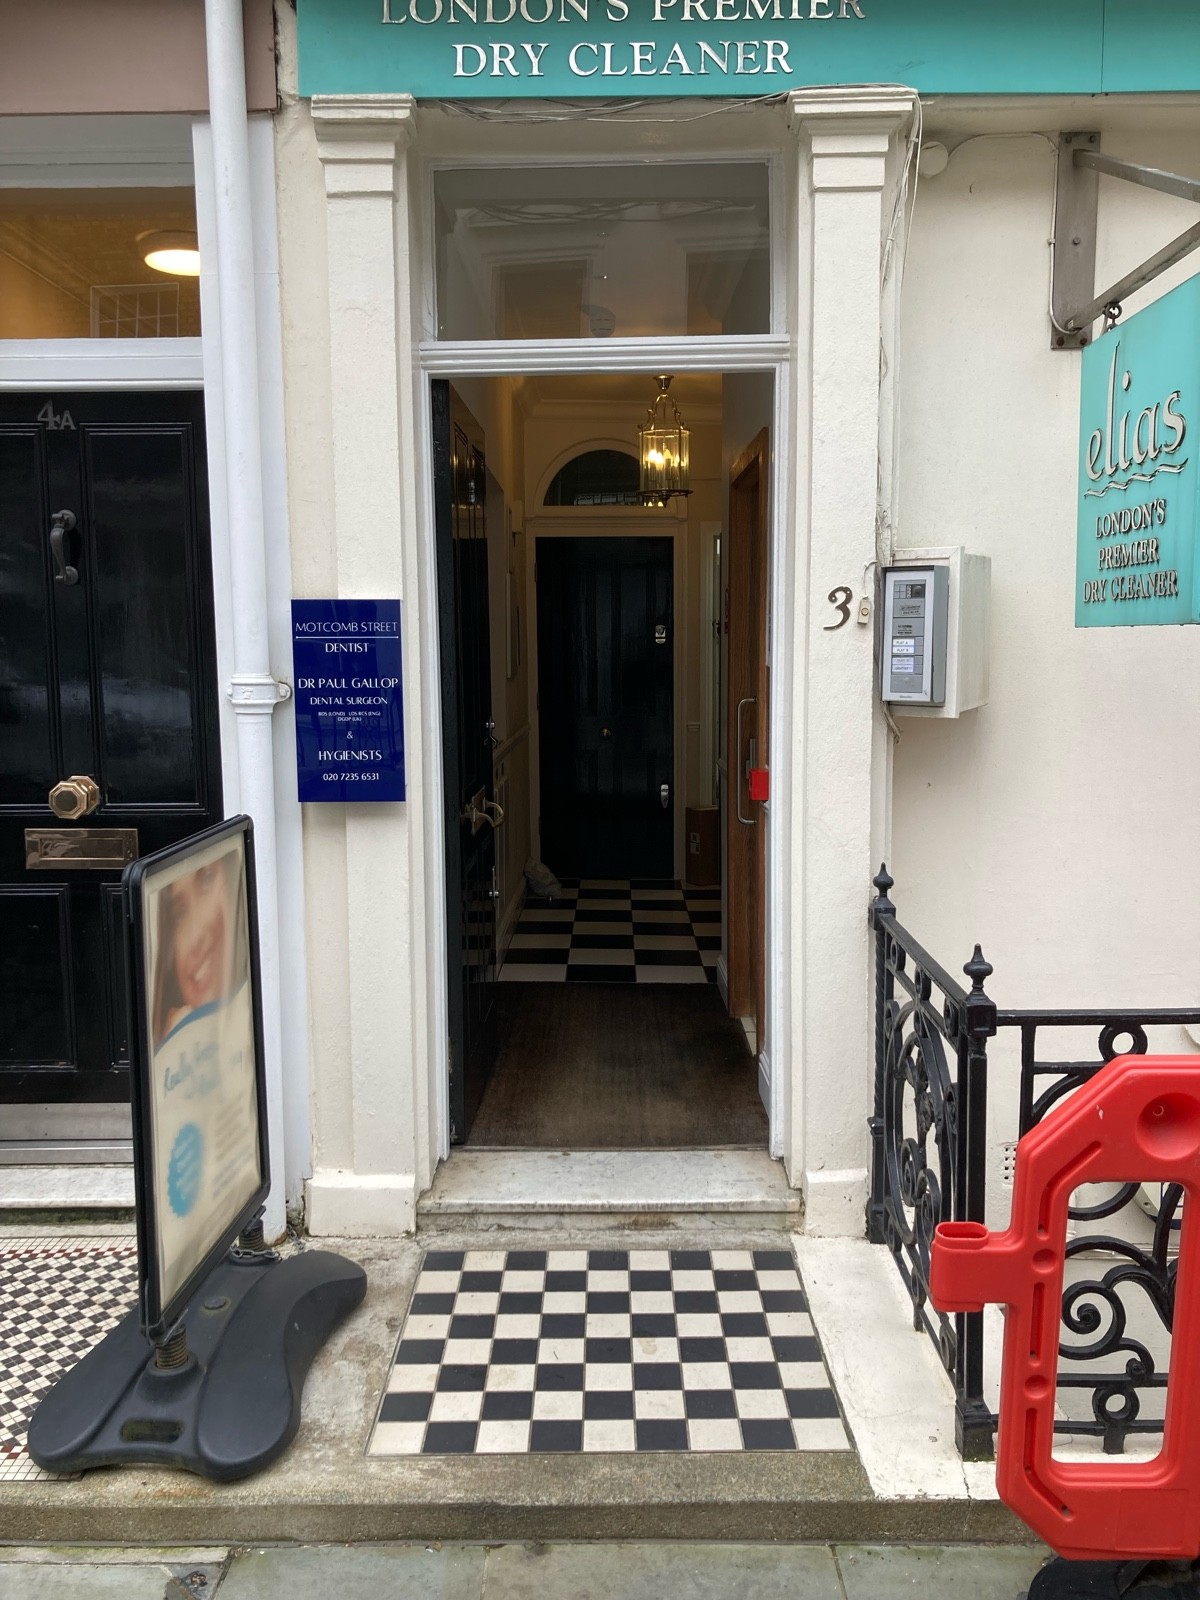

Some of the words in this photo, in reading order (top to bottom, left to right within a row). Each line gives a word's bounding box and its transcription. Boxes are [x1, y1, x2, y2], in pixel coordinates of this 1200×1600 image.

[380, 0, 629, 25] LONDONS
[651, 0, 867, 21] PREMIER
[452, 43, 549, 77] DRY
[568, 40, 794, 76] CLEANER
[37, 400, 77, 430] 4A
[1086, 340, 1186, 482] elias
[1095, 498, 1167, 539] LONDON'S
[1098, 538, 1160, 571] PREMIER
[1083, 579, 1107, 603] DRY
[1111, 570, 1179, 602] CLEANER
[823, 586, 853, 630] 3
[295, 621, 358, 632] MOTCOMB
[360, 621, 398, 632] STREET
[325, 642, 369, 653] DENTIST
[298, 677, 315, 689] DR
[318, 677, 348, 689] PAUL
[351, 677, 399, 689] GALLOP
[310, 696, 344, 705] DENTAL
[346, 696, 388, 705] SURGEON
[346, 730, 354, 739] &
[318, 750, 383, 761] HYGIENISTS
[323, 773, 339, 781] 020
[340, 773, 360, 781] 7235
[361, 772, 380, 781] 6531
